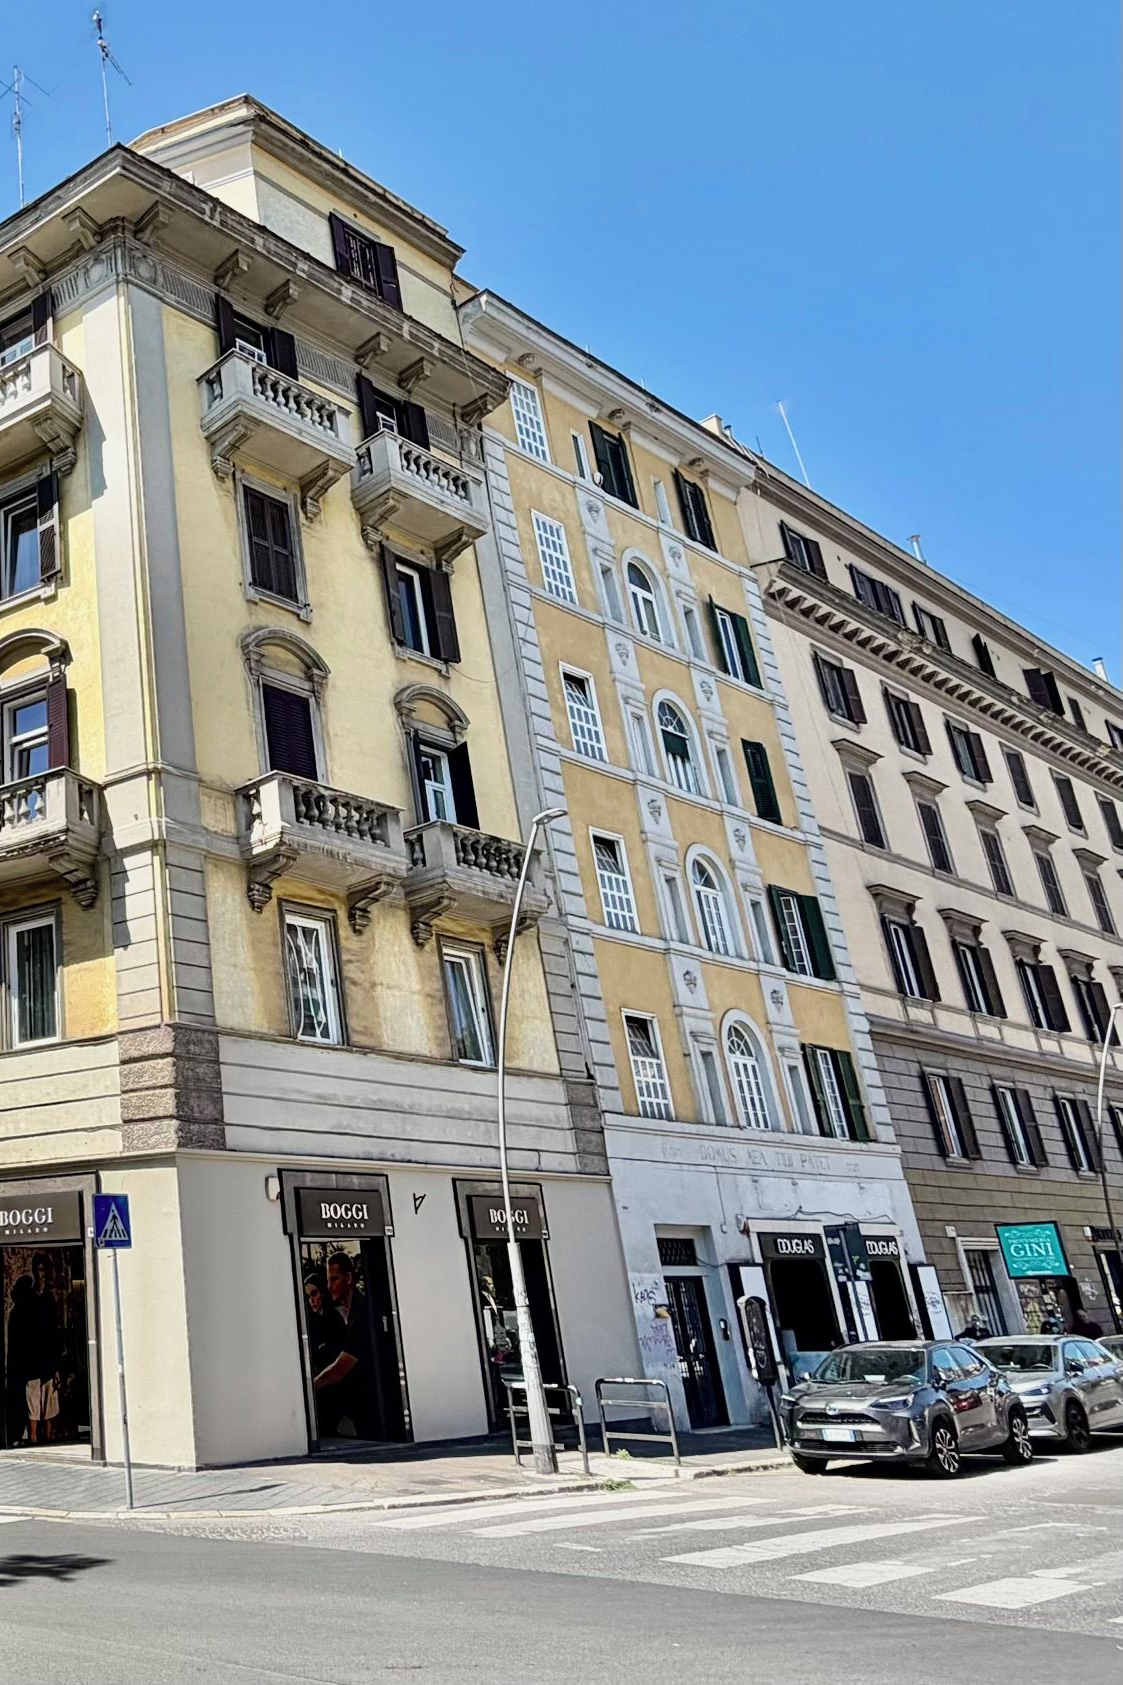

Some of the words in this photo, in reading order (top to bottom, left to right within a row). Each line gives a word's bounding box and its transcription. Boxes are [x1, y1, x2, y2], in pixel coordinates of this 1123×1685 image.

[320, 1203, 369, 1220] BOGGI
[777, 1239, 814, 1254] DOUGLAS
[866, 1241, 898, 1255] DOUGLAS
[1010, 1242, 1054, 1257] GINI
